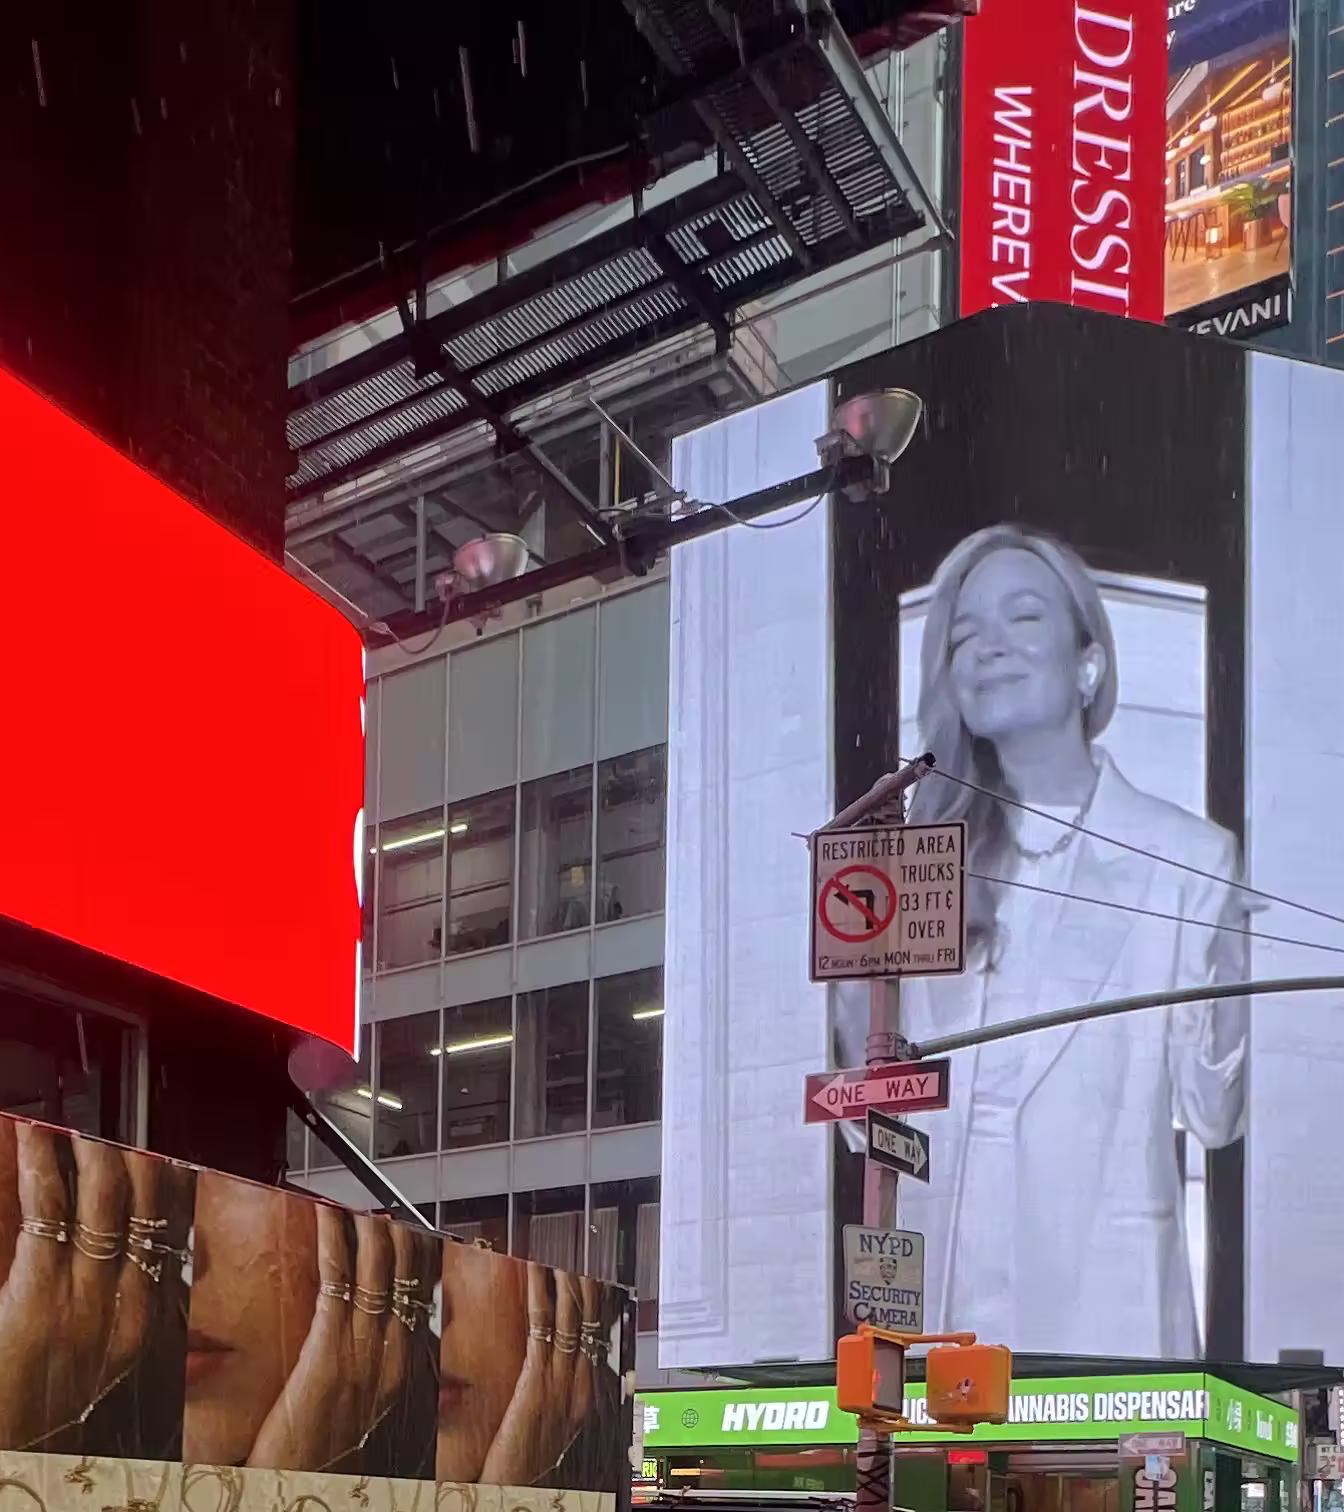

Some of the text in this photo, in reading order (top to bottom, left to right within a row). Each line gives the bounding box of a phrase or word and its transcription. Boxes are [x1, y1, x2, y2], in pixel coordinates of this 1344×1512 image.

[1188, 294, 1281, 335] EVANI
[823, 835, 956, 861] RESTRICTED AREA
[901, 863, 954, 883] TRUCKS
[900, 893, 919, 911] 33
[926, 891, 941, 910] FT
[908, 920, 945, 939] OVER
[819, 956, 830, 969] 12
[885, 950, 910, 965] MON
[937, 948, 956, 962] FRI
[826, 1076, 929, 1105] ONE WAY
[878, 1129, 921, 1164] ONE WAY
[859, 1232, 913, 1258] NYPD
[721, 1401, 829, 1431] HYDRO
